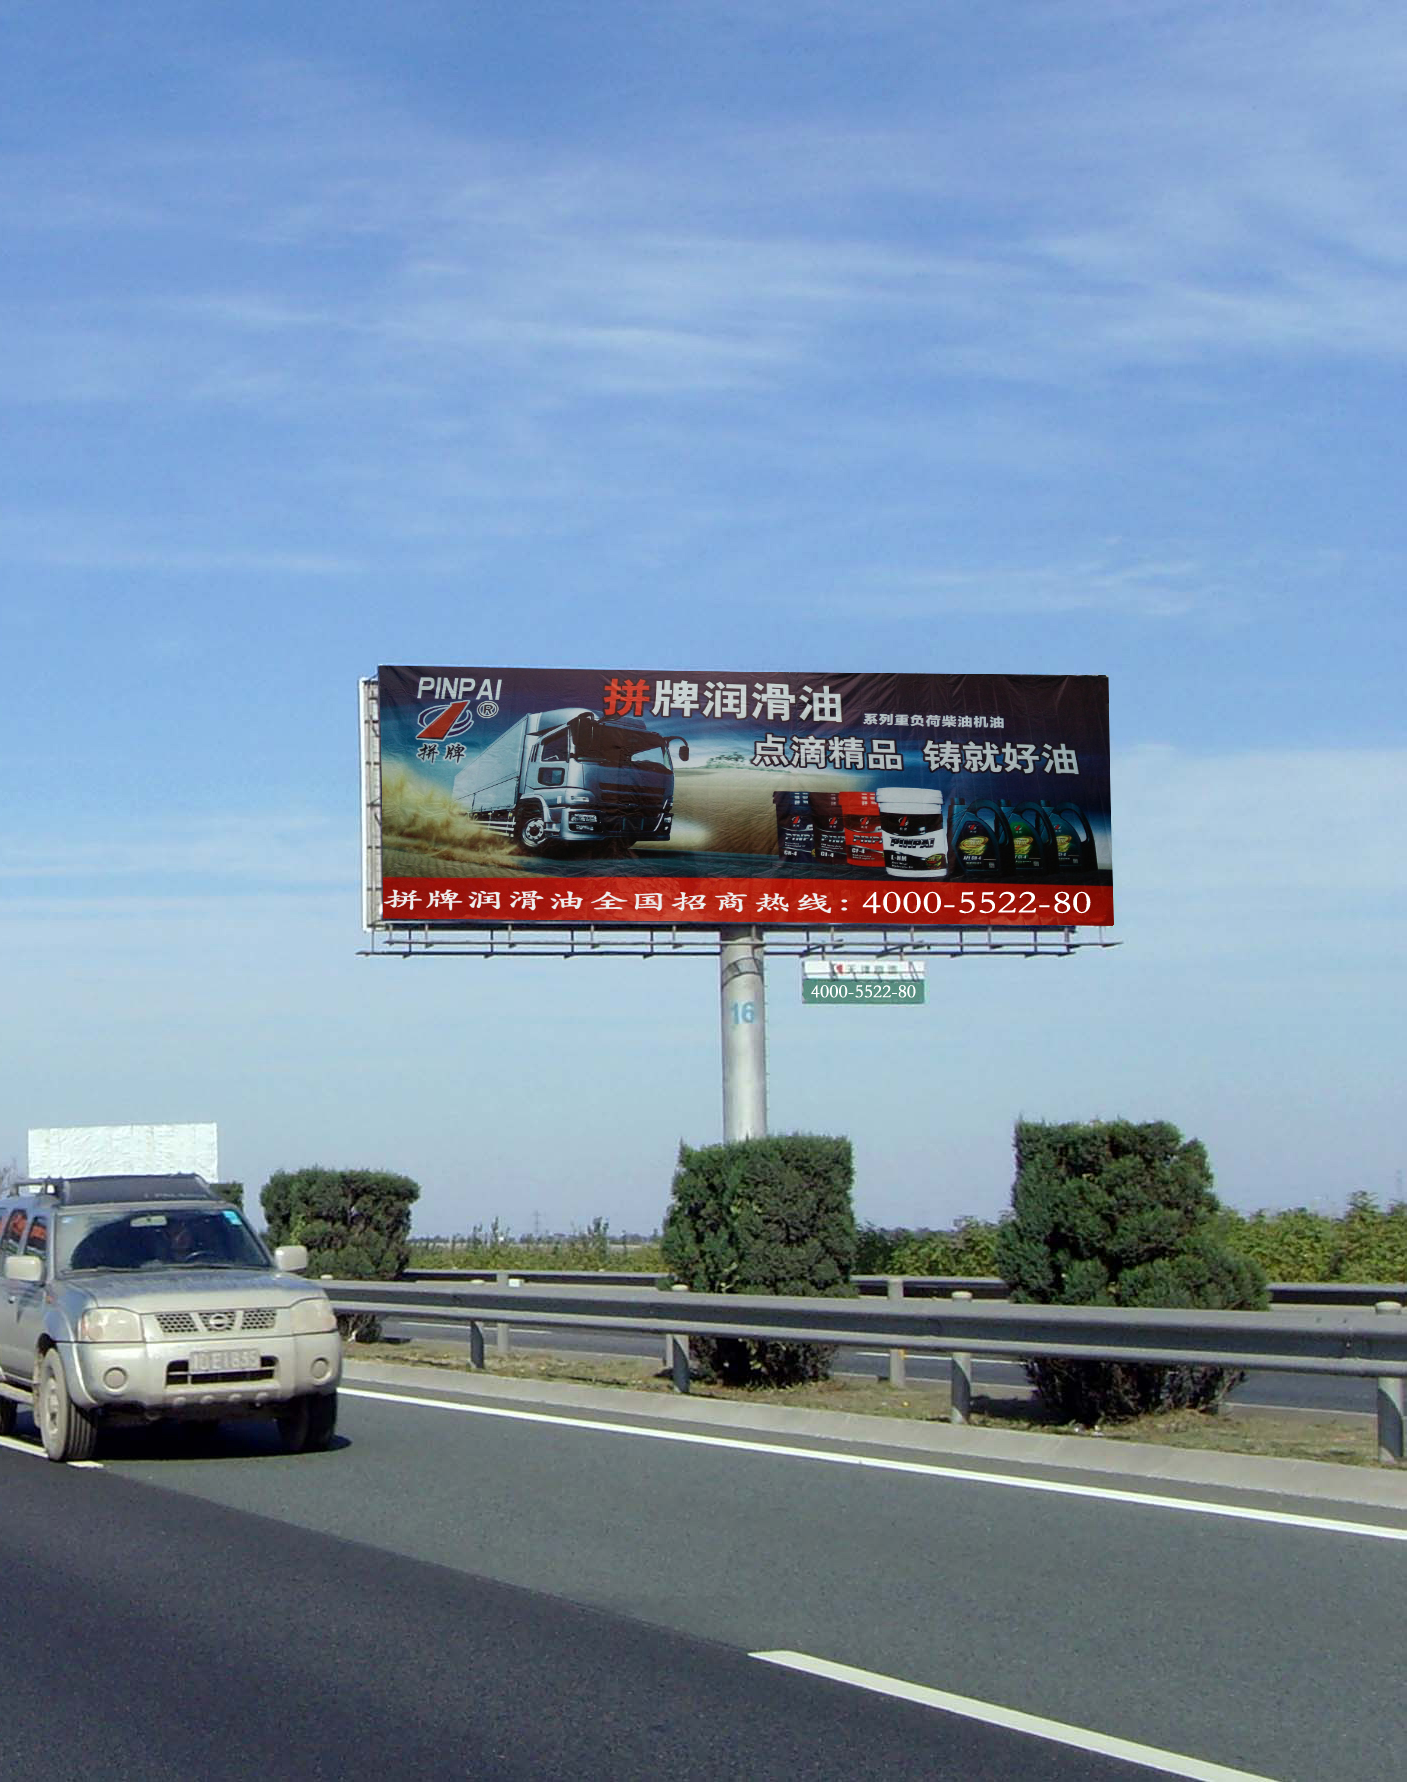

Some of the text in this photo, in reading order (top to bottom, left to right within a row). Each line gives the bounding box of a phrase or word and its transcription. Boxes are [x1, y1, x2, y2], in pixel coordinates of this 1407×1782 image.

[417, 677, 502, 700] PINPAI
[603, 678, 843, 722] 拼牌润滑油
[862, 713, 1005, 729] 系列重负荷柴油机油
[417, 743, 466, 764] 拼牌
[752, 734, 1080, 775] 点滴精品 铸就好油
[810, 985, 916, 999] 4000-5522-80
